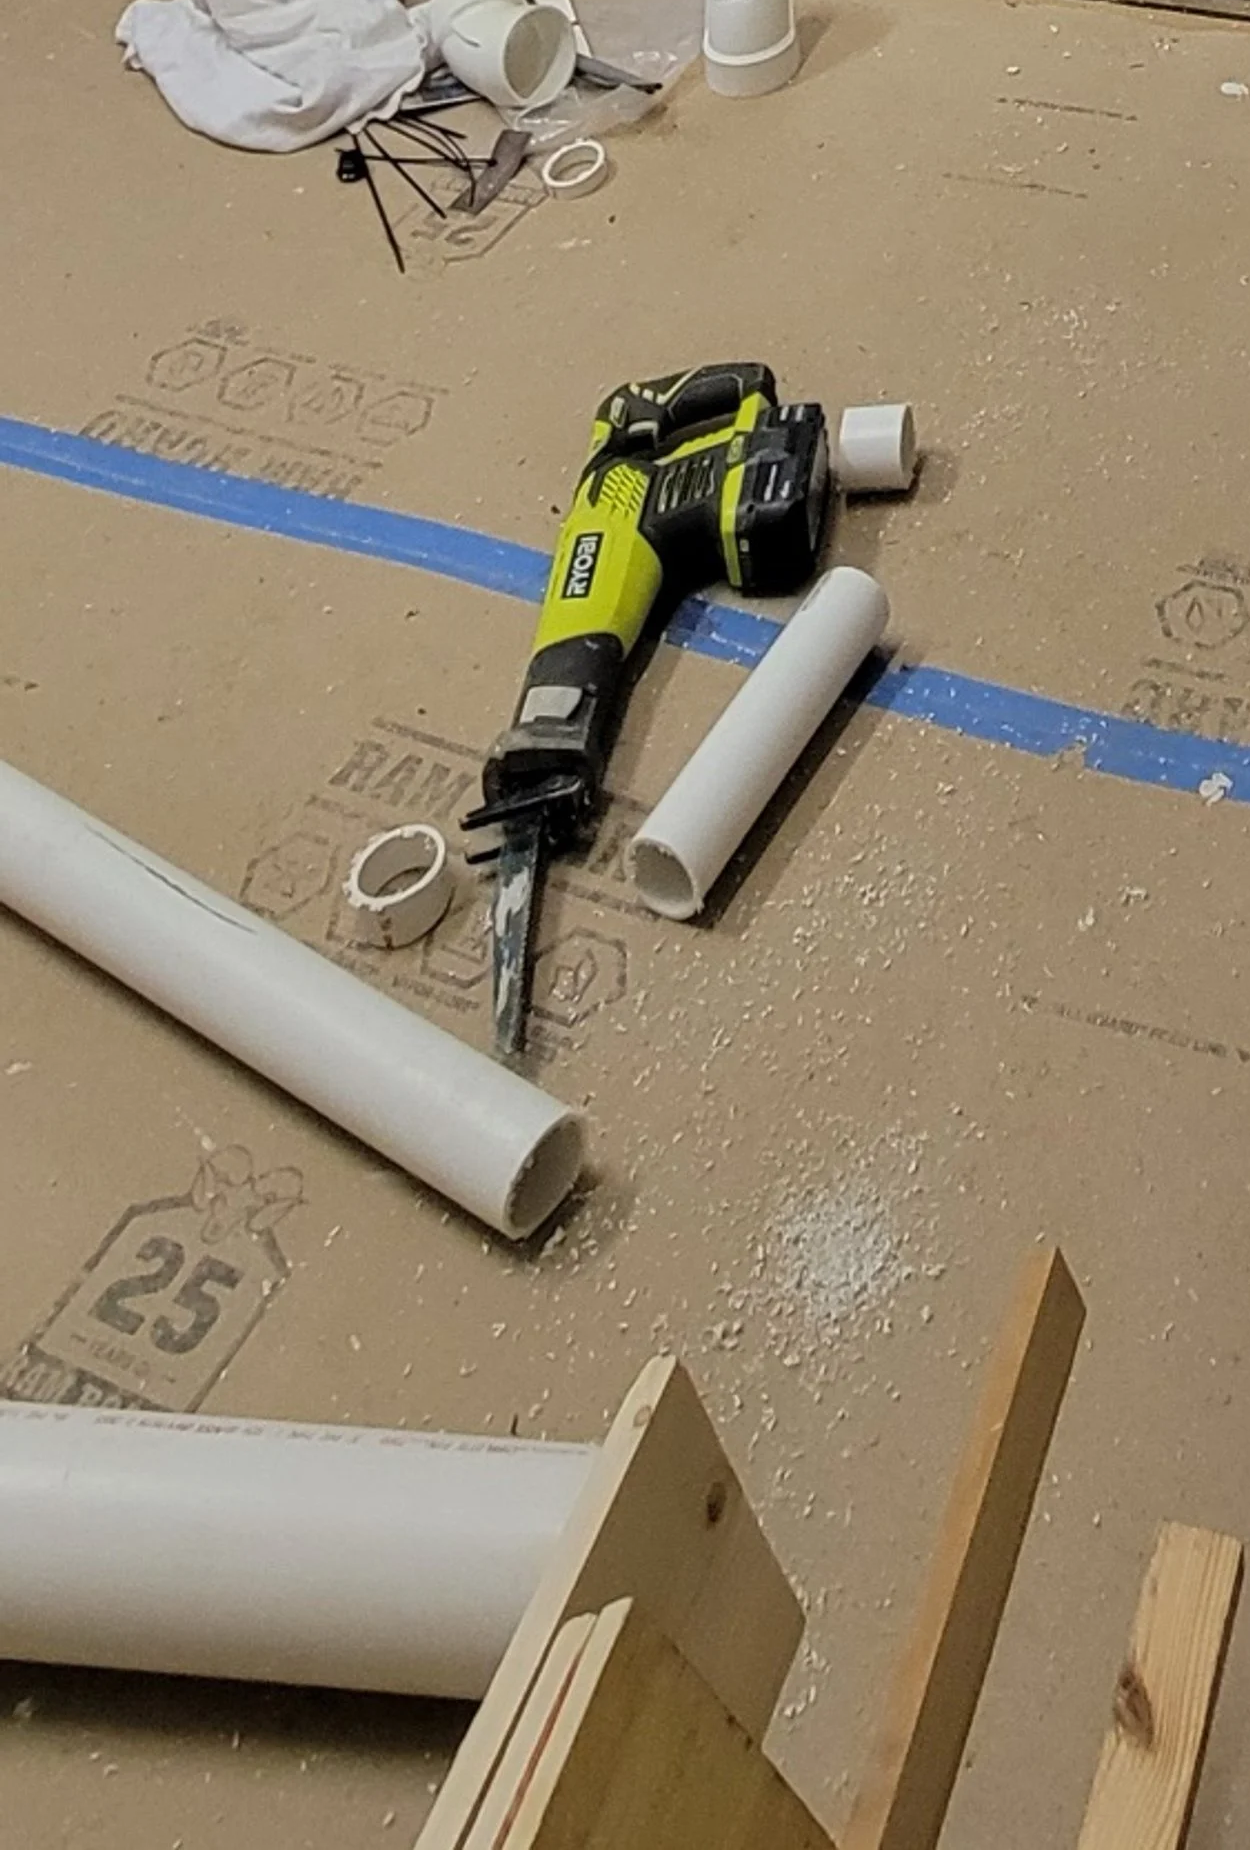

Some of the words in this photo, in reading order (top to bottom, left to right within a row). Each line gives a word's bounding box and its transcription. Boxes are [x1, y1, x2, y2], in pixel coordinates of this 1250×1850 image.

[566, 535, 599, 596] RYOBI
[327, 739, 480, 820] RAM
[87, 1235, 245, 1354] 25
